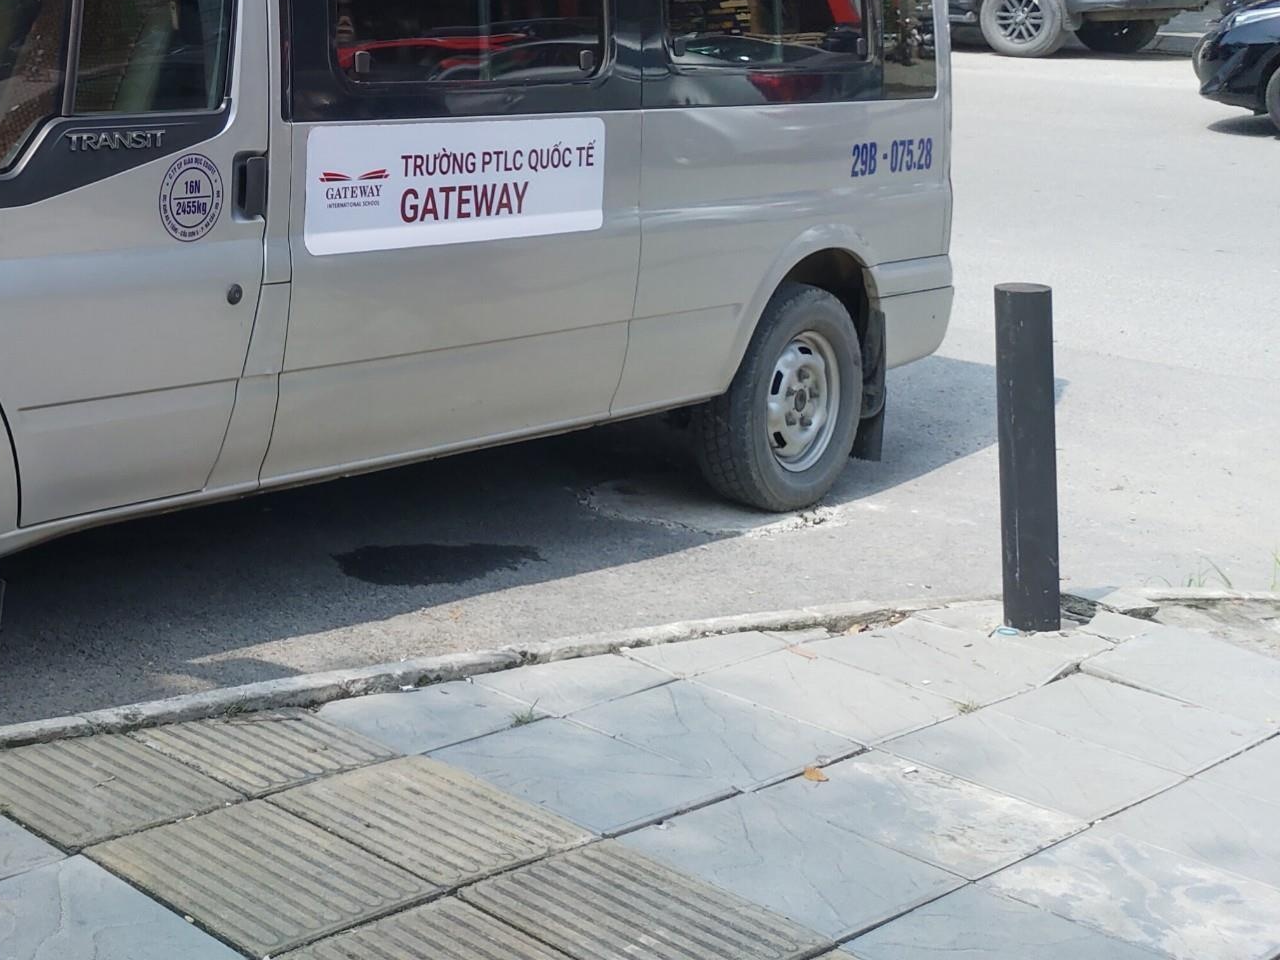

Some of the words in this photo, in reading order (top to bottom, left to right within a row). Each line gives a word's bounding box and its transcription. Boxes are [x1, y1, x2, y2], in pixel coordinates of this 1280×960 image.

[65, 130, 166, 151] TRANSIT
[401, 147, 477, 178] TRƯỜNG
[481, 149, 524, 173] PTLC
[528, 140, 572, 171] QUỐC
[576, 139, 597, 167] TẾ
[850, 142, 878, 177] 29B
[889, 138, 933, 173] 075.28
[184, 180, 200, 195] 16N
[325, 185, 382, 200] GATEWAY
[176, 200, 207, 216] 2455kg
[327, 200, 361, 208] INTERNATIONAL
[400, 181, 529, 223] GATEWAY
